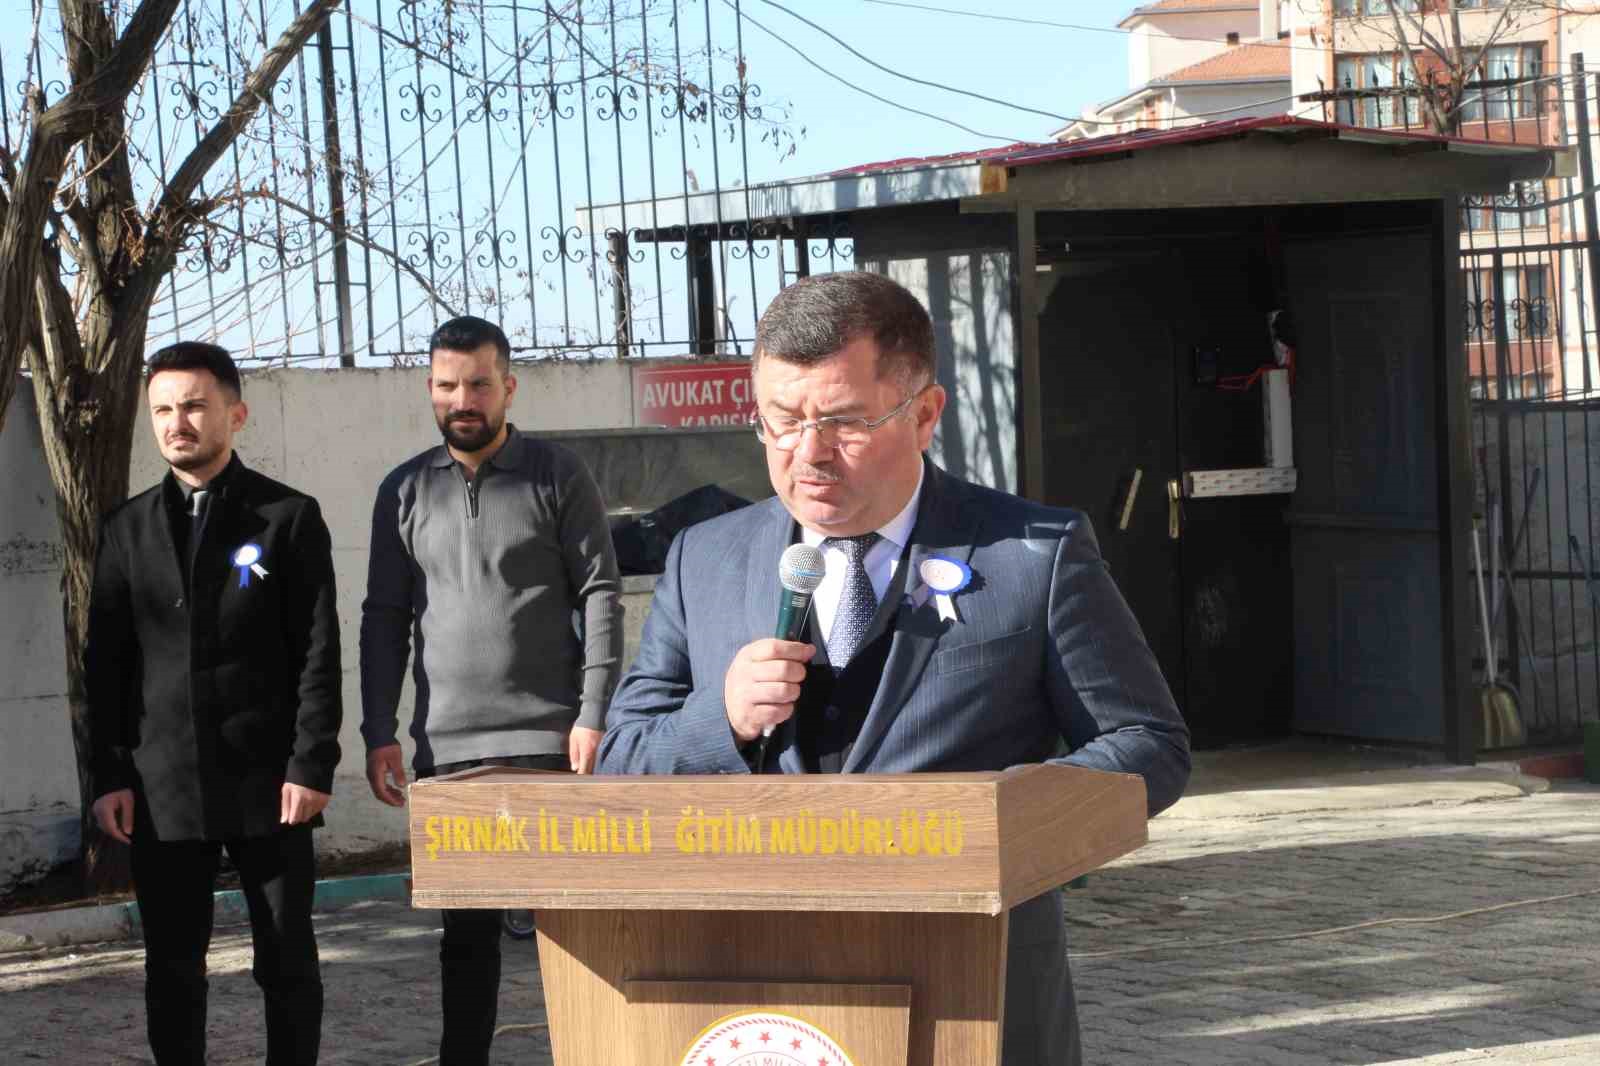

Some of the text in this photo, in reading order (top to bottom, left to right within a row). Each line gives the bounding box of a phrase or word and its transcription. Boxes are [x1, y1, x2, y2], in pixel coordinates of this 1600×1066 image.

[643, 379, 725, 408] AVUKAT
[424, 815, 530, 860] ŞIRNAK
[538, 808, 565, 853] İL
[573, 808, 652, 853] MİLLİ
[770, 808, 964, 856] MÜDÜRLÜĞÜ
